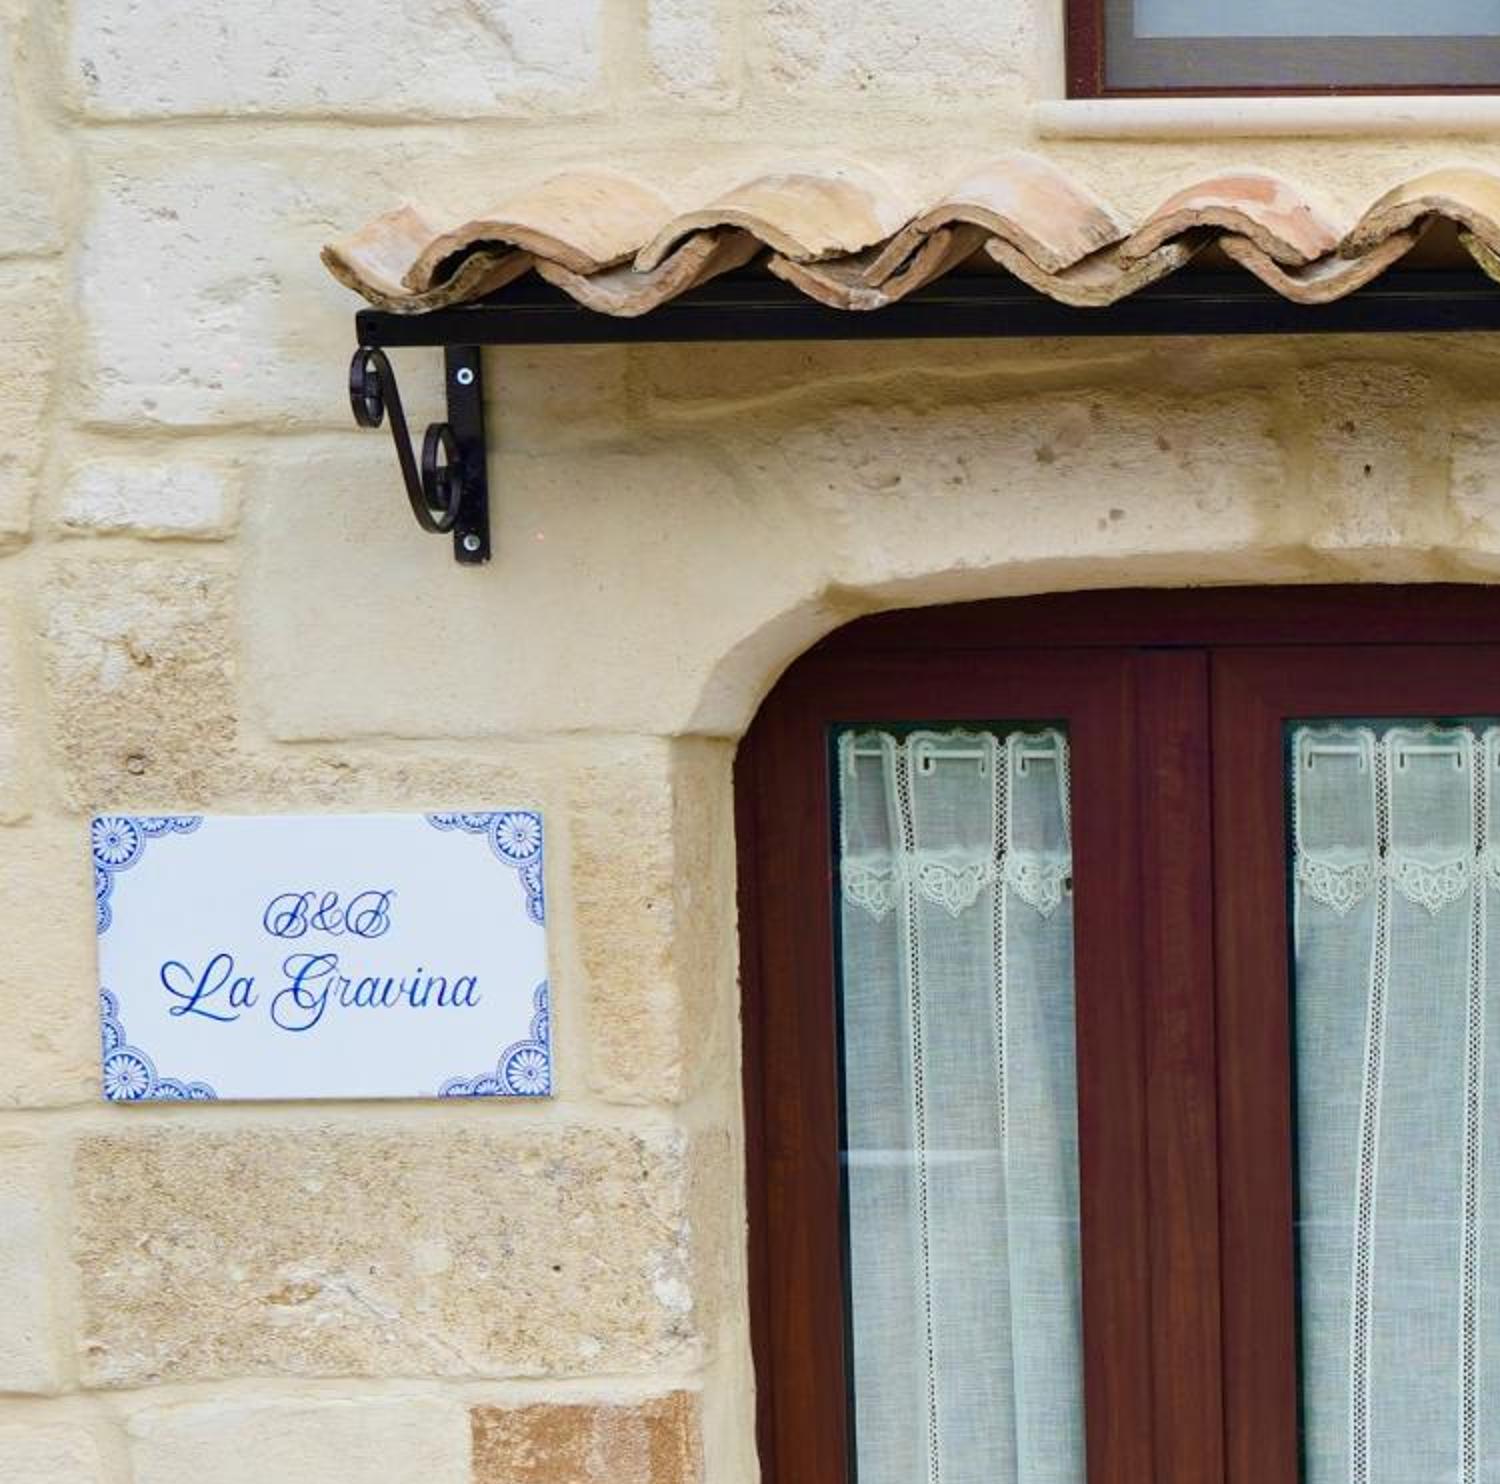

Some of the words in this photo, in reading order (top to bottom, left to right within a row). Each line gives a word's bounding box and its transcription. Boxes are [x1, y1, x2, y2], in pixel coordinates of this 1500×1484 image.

[263, 889, 397, 938] B&B
[160, 953, 258, 1022] La
[271, 953, 480, 1031] Gravina
